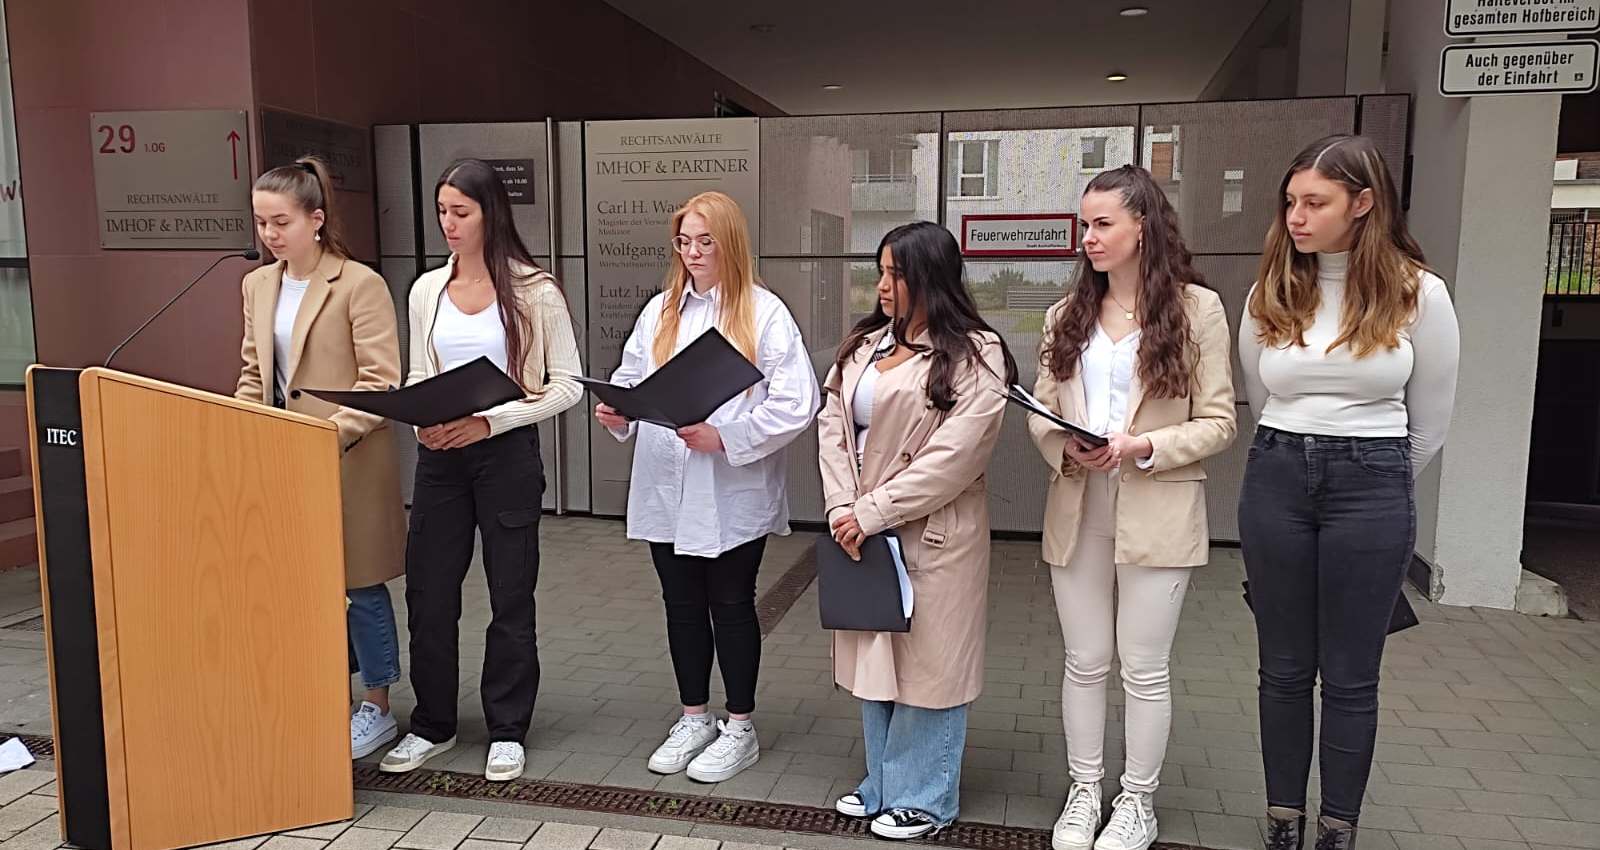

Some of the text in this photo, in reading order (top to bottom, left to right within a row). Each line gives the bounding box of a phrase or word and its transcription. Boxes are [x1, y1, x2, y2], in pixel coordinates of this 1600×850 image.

[1454, 7, 1596, 28] gesamten Hofbereich
[1465, 51, 1574, 69] Auch gegenüber
[1478, 70, 1558, 86] der Einfahrt
[98, 125, 166, 153] 29 1.OG
[620, 132, 722, 146] RECHTSANWÄLTE
[596, 158, 749, 175] IMHOF & PARTNER
[127, 191, 219, 205] RECHTSANWÄLTE
[597, 200, 627, 214] Carl
[632, 200, 647, 214] H.
[107, 218, 245, 232] IMHOF & PARTNER
[971, 228, 1067, 242] Feuerwehrzufahrt
[599, 242, 666, 260] Wolfgang
[600, 285, 665, 298] Lutz Imh
[600, 326, 628, 340] Mar
[46, 428, 77, 446] ITEC
